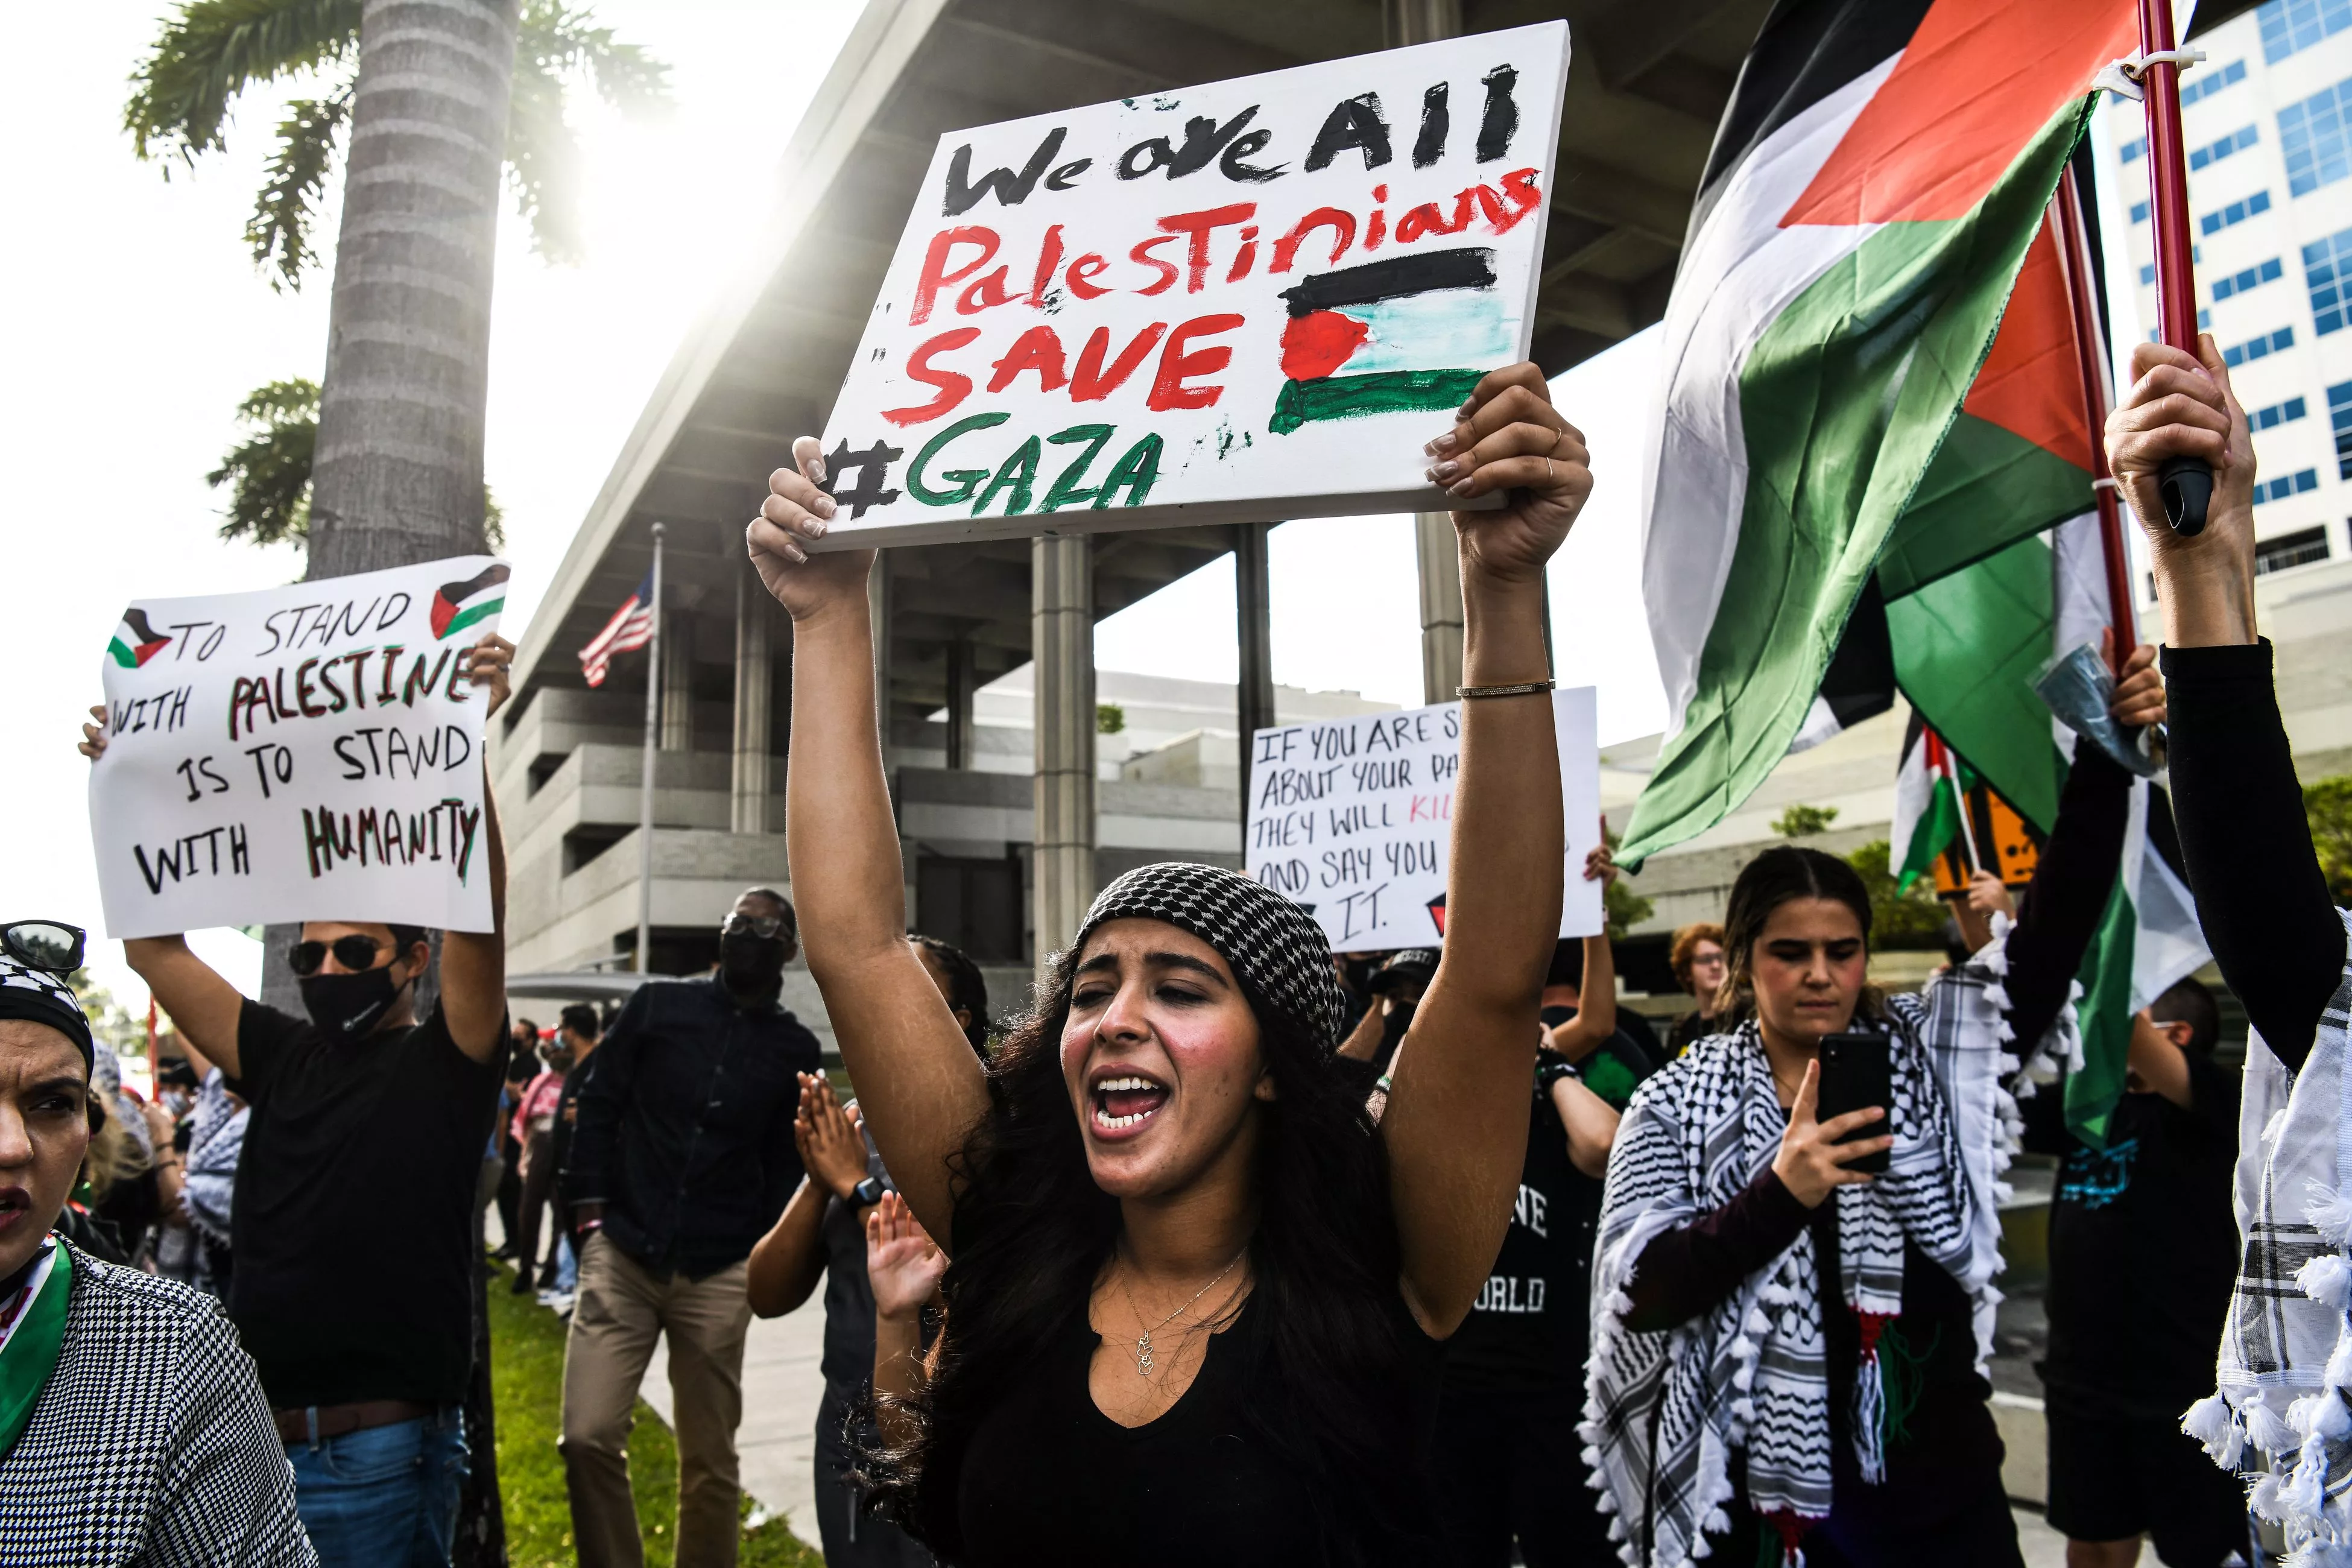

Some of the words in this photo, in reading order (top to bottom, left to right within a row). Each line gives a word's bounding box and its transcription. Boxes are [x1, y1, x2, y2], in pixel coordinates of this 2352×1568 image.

[942, 127, 1094, 217] We
[1115, 104, 1291, 185] are
[881, 313, 1245, 428] SAVE
[169, 620, 226, 662] TO
[256, 592, 411, 657] STAND
[110, 686, 192, 737] WITH
[228, 643, 476, 742] PALESTINE
[176, 756, 229, 803] IS
[244, 743, 292, 800] TO
[333, 725, 470, 780] STAND
[1258, 727, 1303, 764] IF
[1312, 724, 1356, 762] YOU
[1366, 713, 1433, 754] ARE
[1443, 709, 1461, 739] S
[1260, 763, 1344, 810] ABOUT
[1352, 757, 1413, 793] YOUR
[133, 823, 249, 894] WITH
[301, 798, 480, 888] HUMANITY
[1251, 811, 1315, 849] THEY
[1330, 802, 1395, 837] WILL
[1259, 858, 1310, 896] AND
[1321, 847, 1371, 889] SAY
[1385, 841, 1437, 876] YOU
[1335, 883, 1388, 944] IT.
